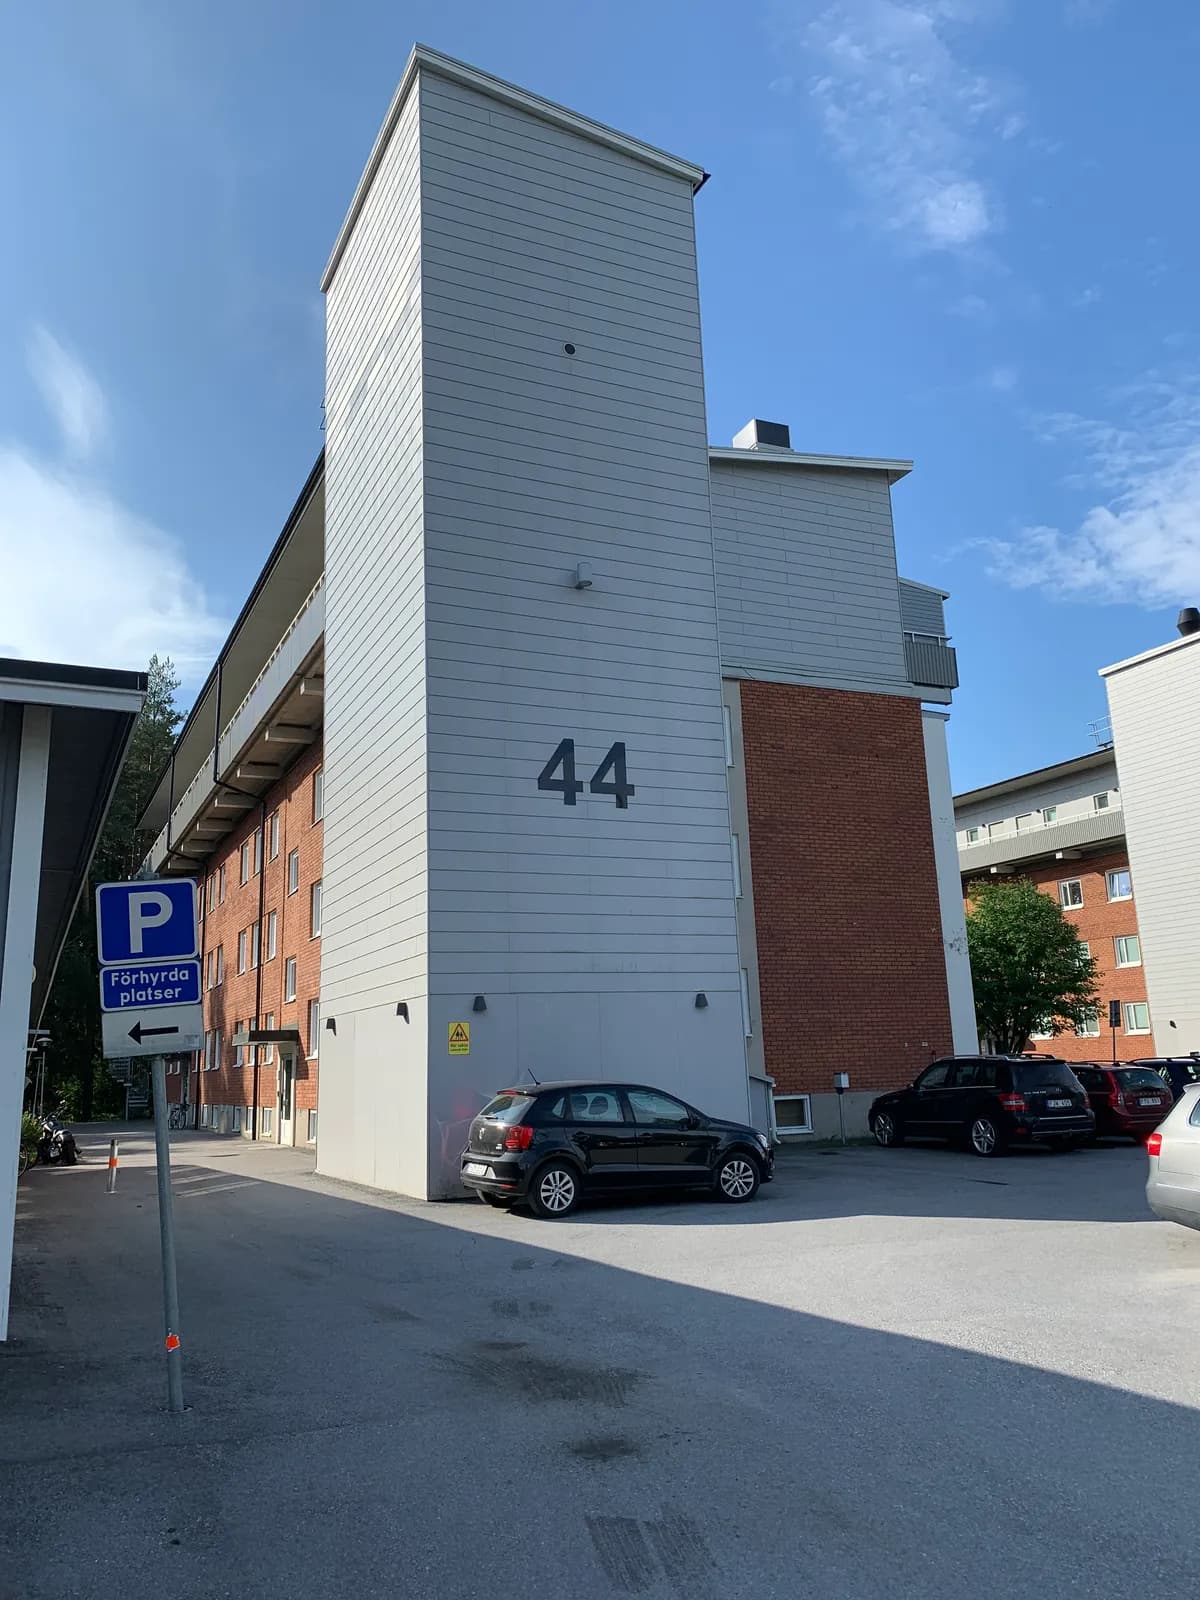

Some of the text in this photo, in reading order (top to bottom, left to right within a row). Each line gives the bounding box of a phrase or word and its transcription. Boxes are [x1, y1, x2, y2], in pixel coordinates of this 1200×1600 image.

[538, 738, 634, 809] 44
[128, 891, 173, 953] P
[111, 968, 189, 987] Förhyrda
[120, 987, 182, 1006] platser
